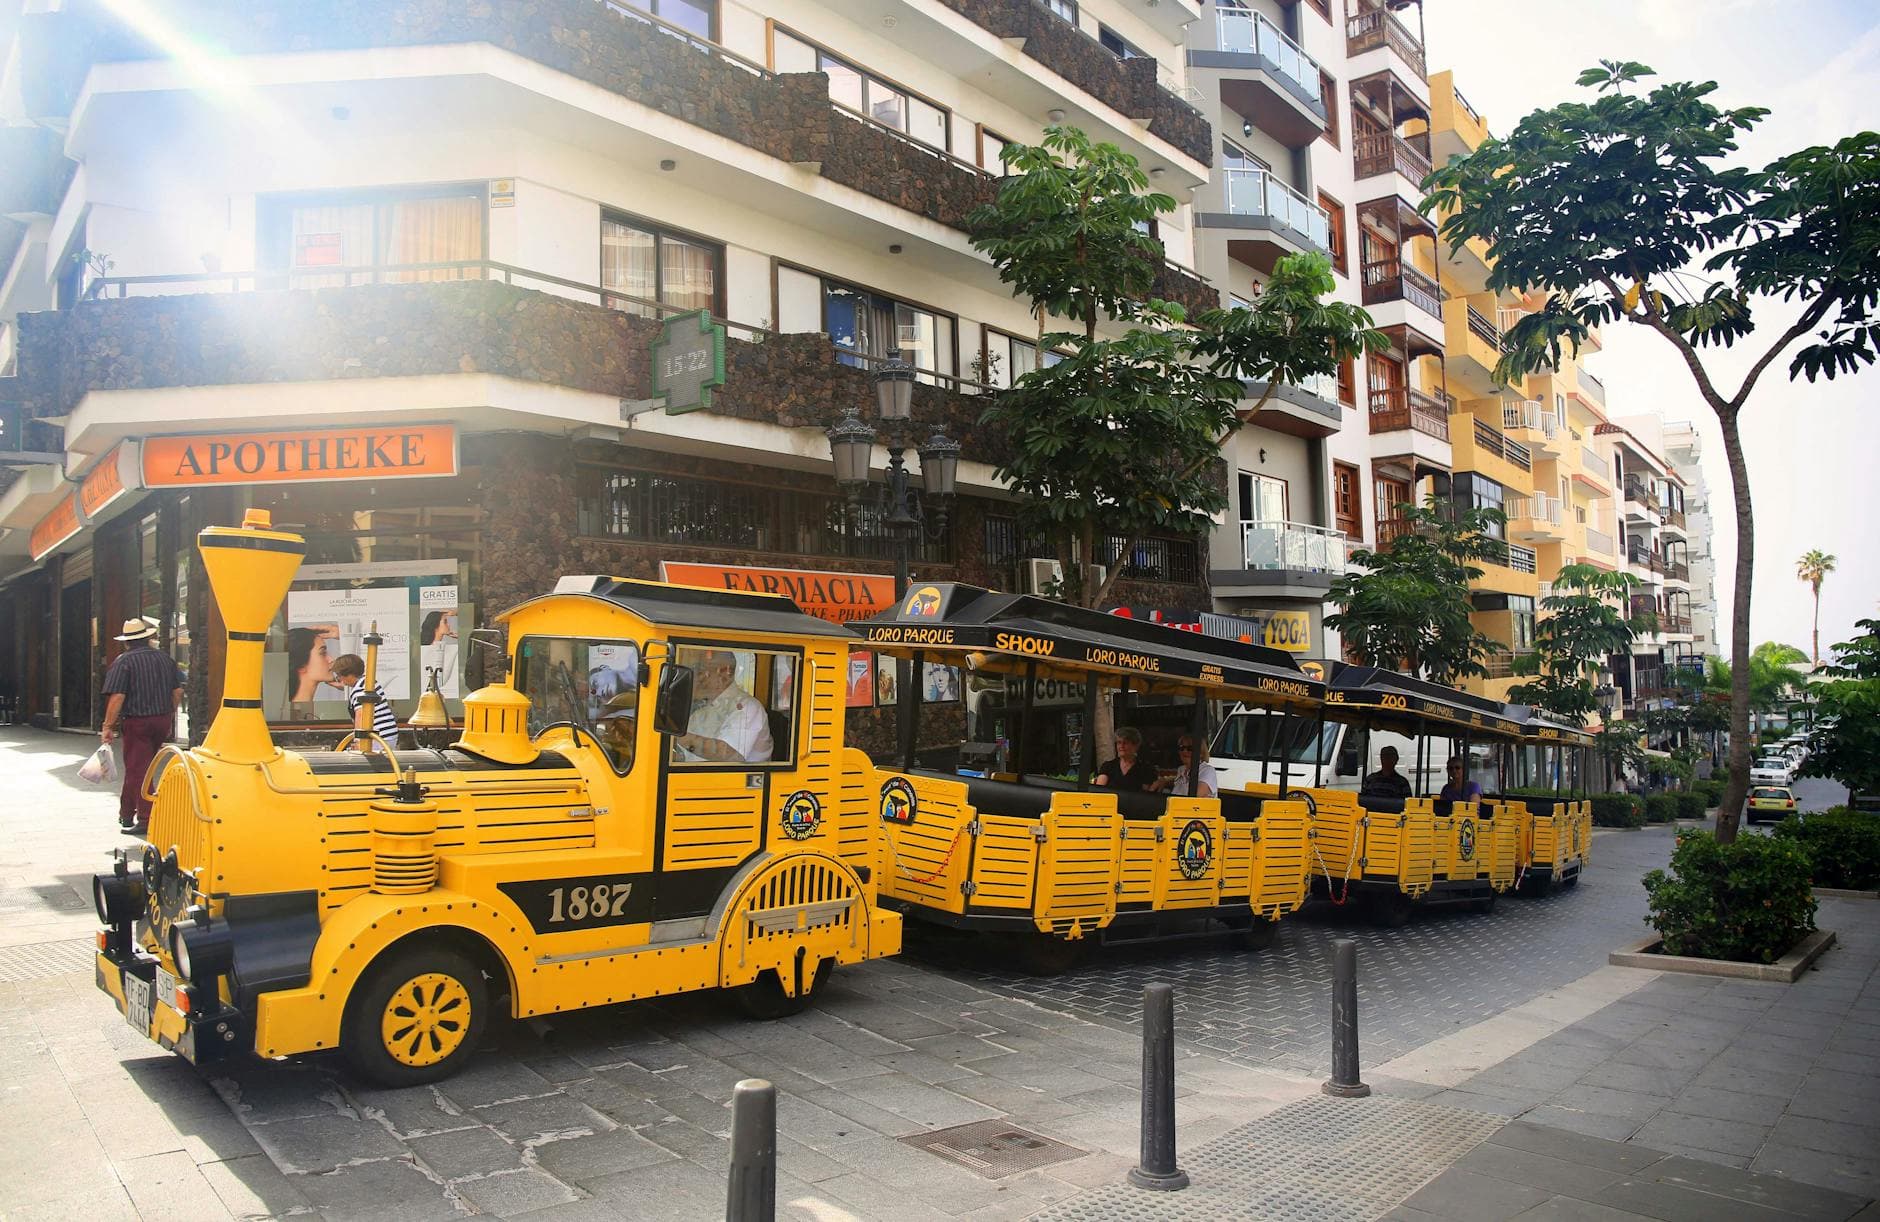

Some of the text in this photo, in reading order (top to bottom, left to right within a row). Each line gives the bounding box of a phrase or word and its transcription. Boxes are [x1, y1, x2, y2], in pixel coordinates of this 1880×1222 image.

[664, 349, 707, 378] 15:22
[174, 434, 426, 476] APOTHEKE
[422, 590, 456, 599] GRATIS
[723, 572, 874, 605] FARMACIA
[868, 628, 954, 645] LORO PARQUE
[1270, 617, 1308, 645] YOGA
[995, 633, 1055, 656] SHOW
[1086, 647, 1160, 672] LORO PARQUE
[1258, 677, 1310, 697] LORO PARQUE
[1381, 694, 1407, 708] ZOO
[783, 818, 820, 841] LORO PARQUE
[1178, 854, 1191, 877] LORO
[548, 883, 632, 922] 1887
[158, 974, 173, 999] SP
